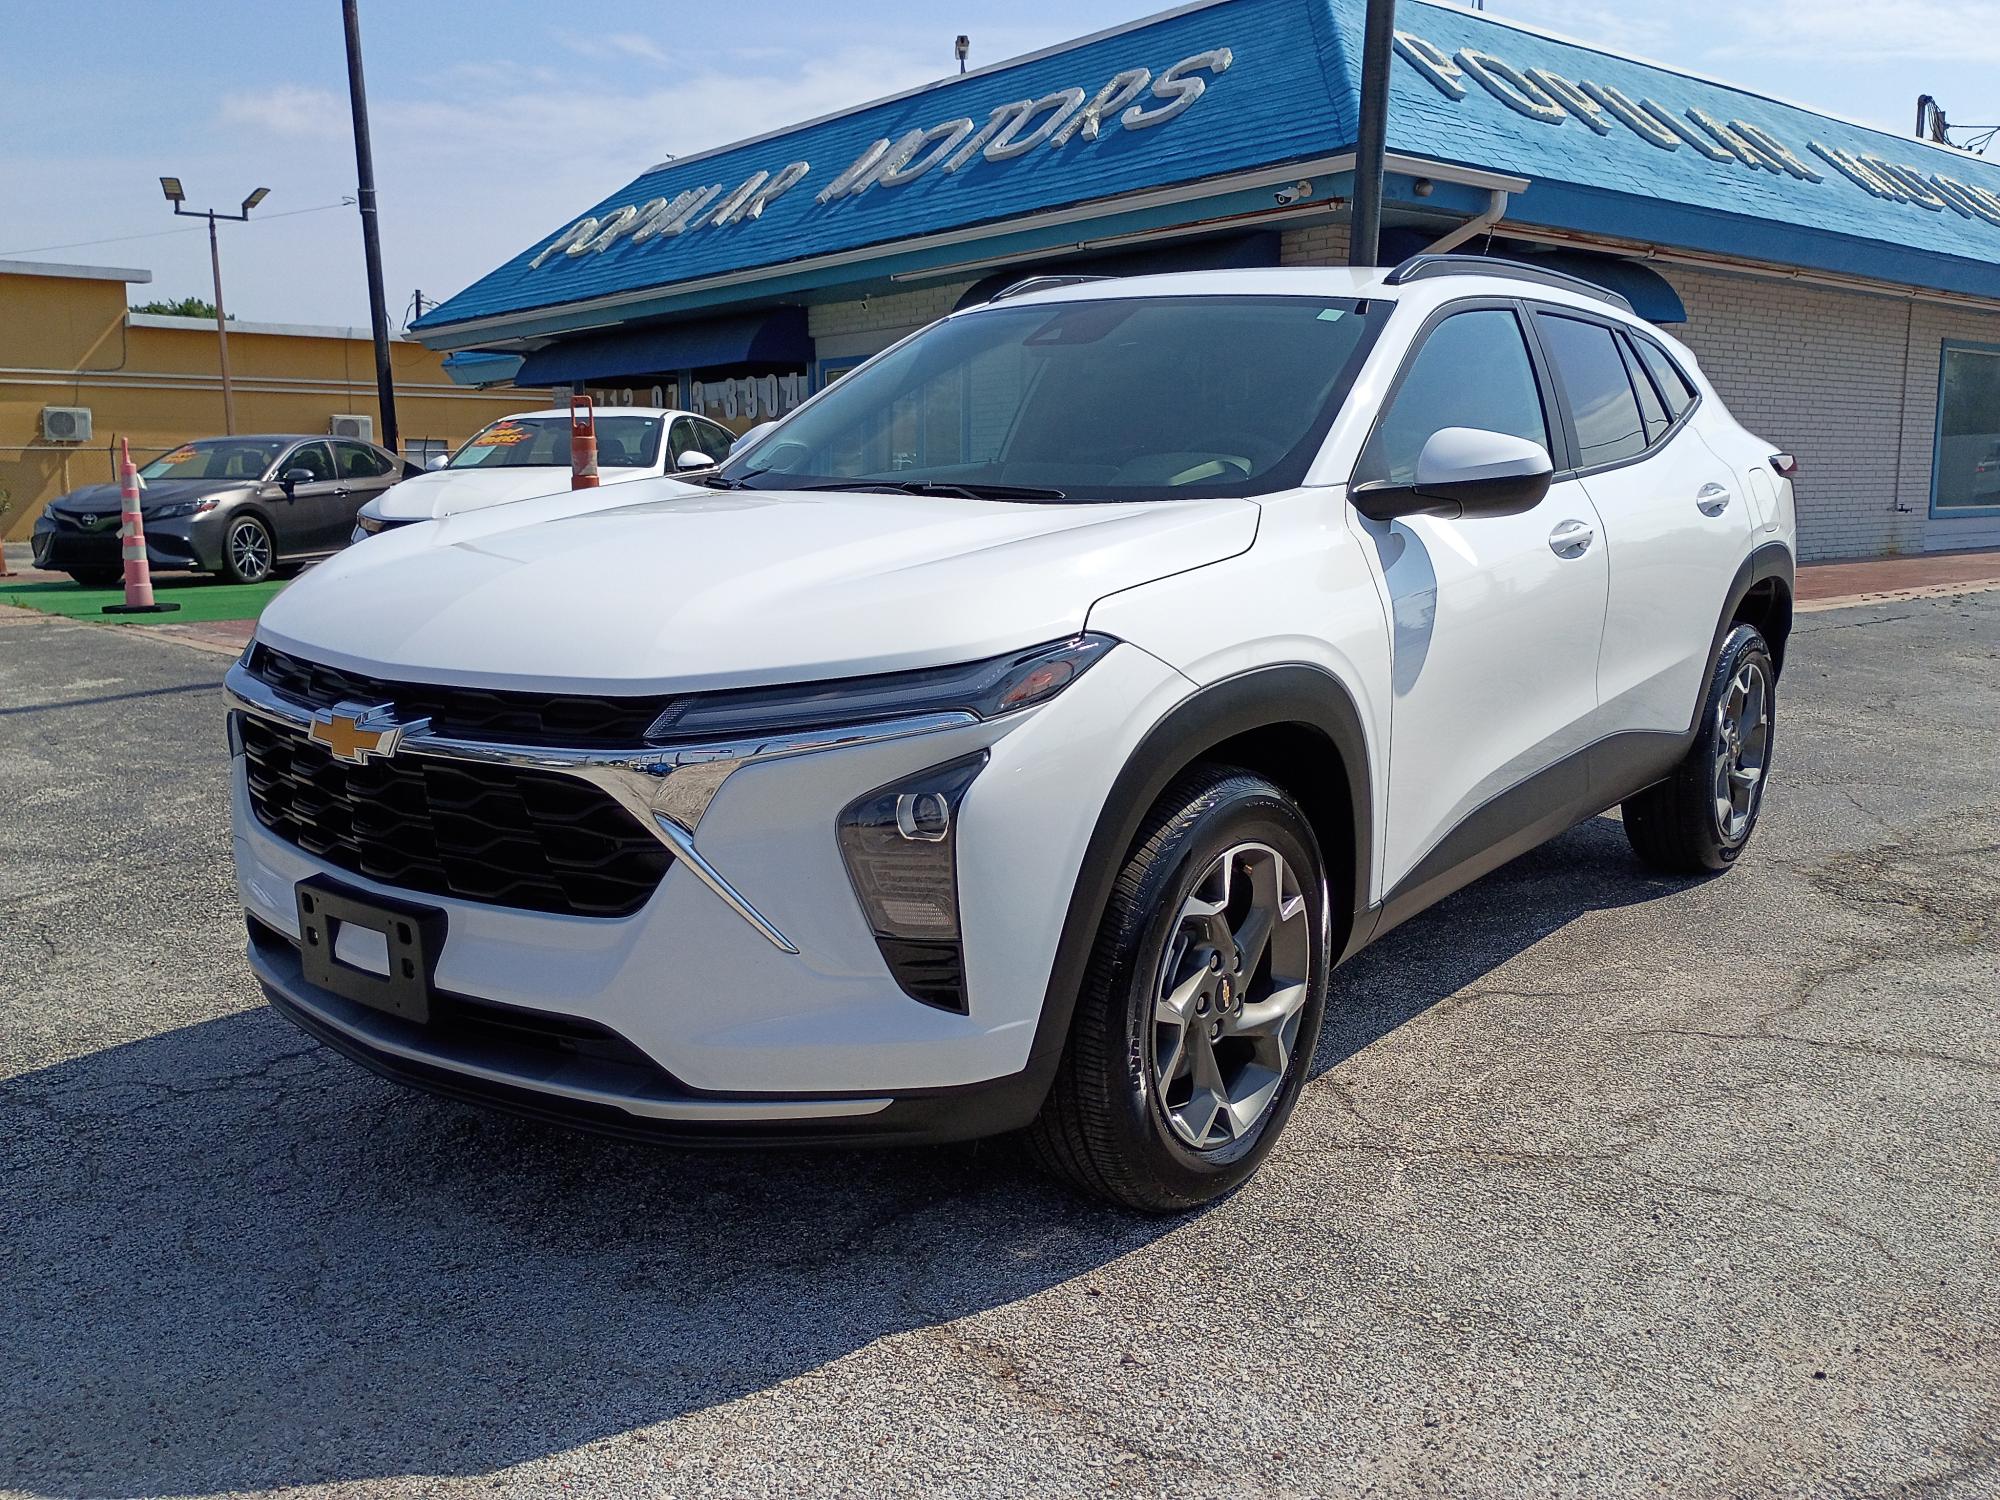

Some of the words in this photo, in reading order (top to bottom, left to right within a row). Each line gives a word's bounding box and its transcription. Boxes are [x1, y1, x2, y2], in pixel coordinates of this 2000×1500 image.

[528, 161, 811, 270] POPULAR
[815, 46, 1234, 204] MOTORS
[1393, 30, 1825, 184] POPULAR
[1805, 141, 2000, 228] MOTO
